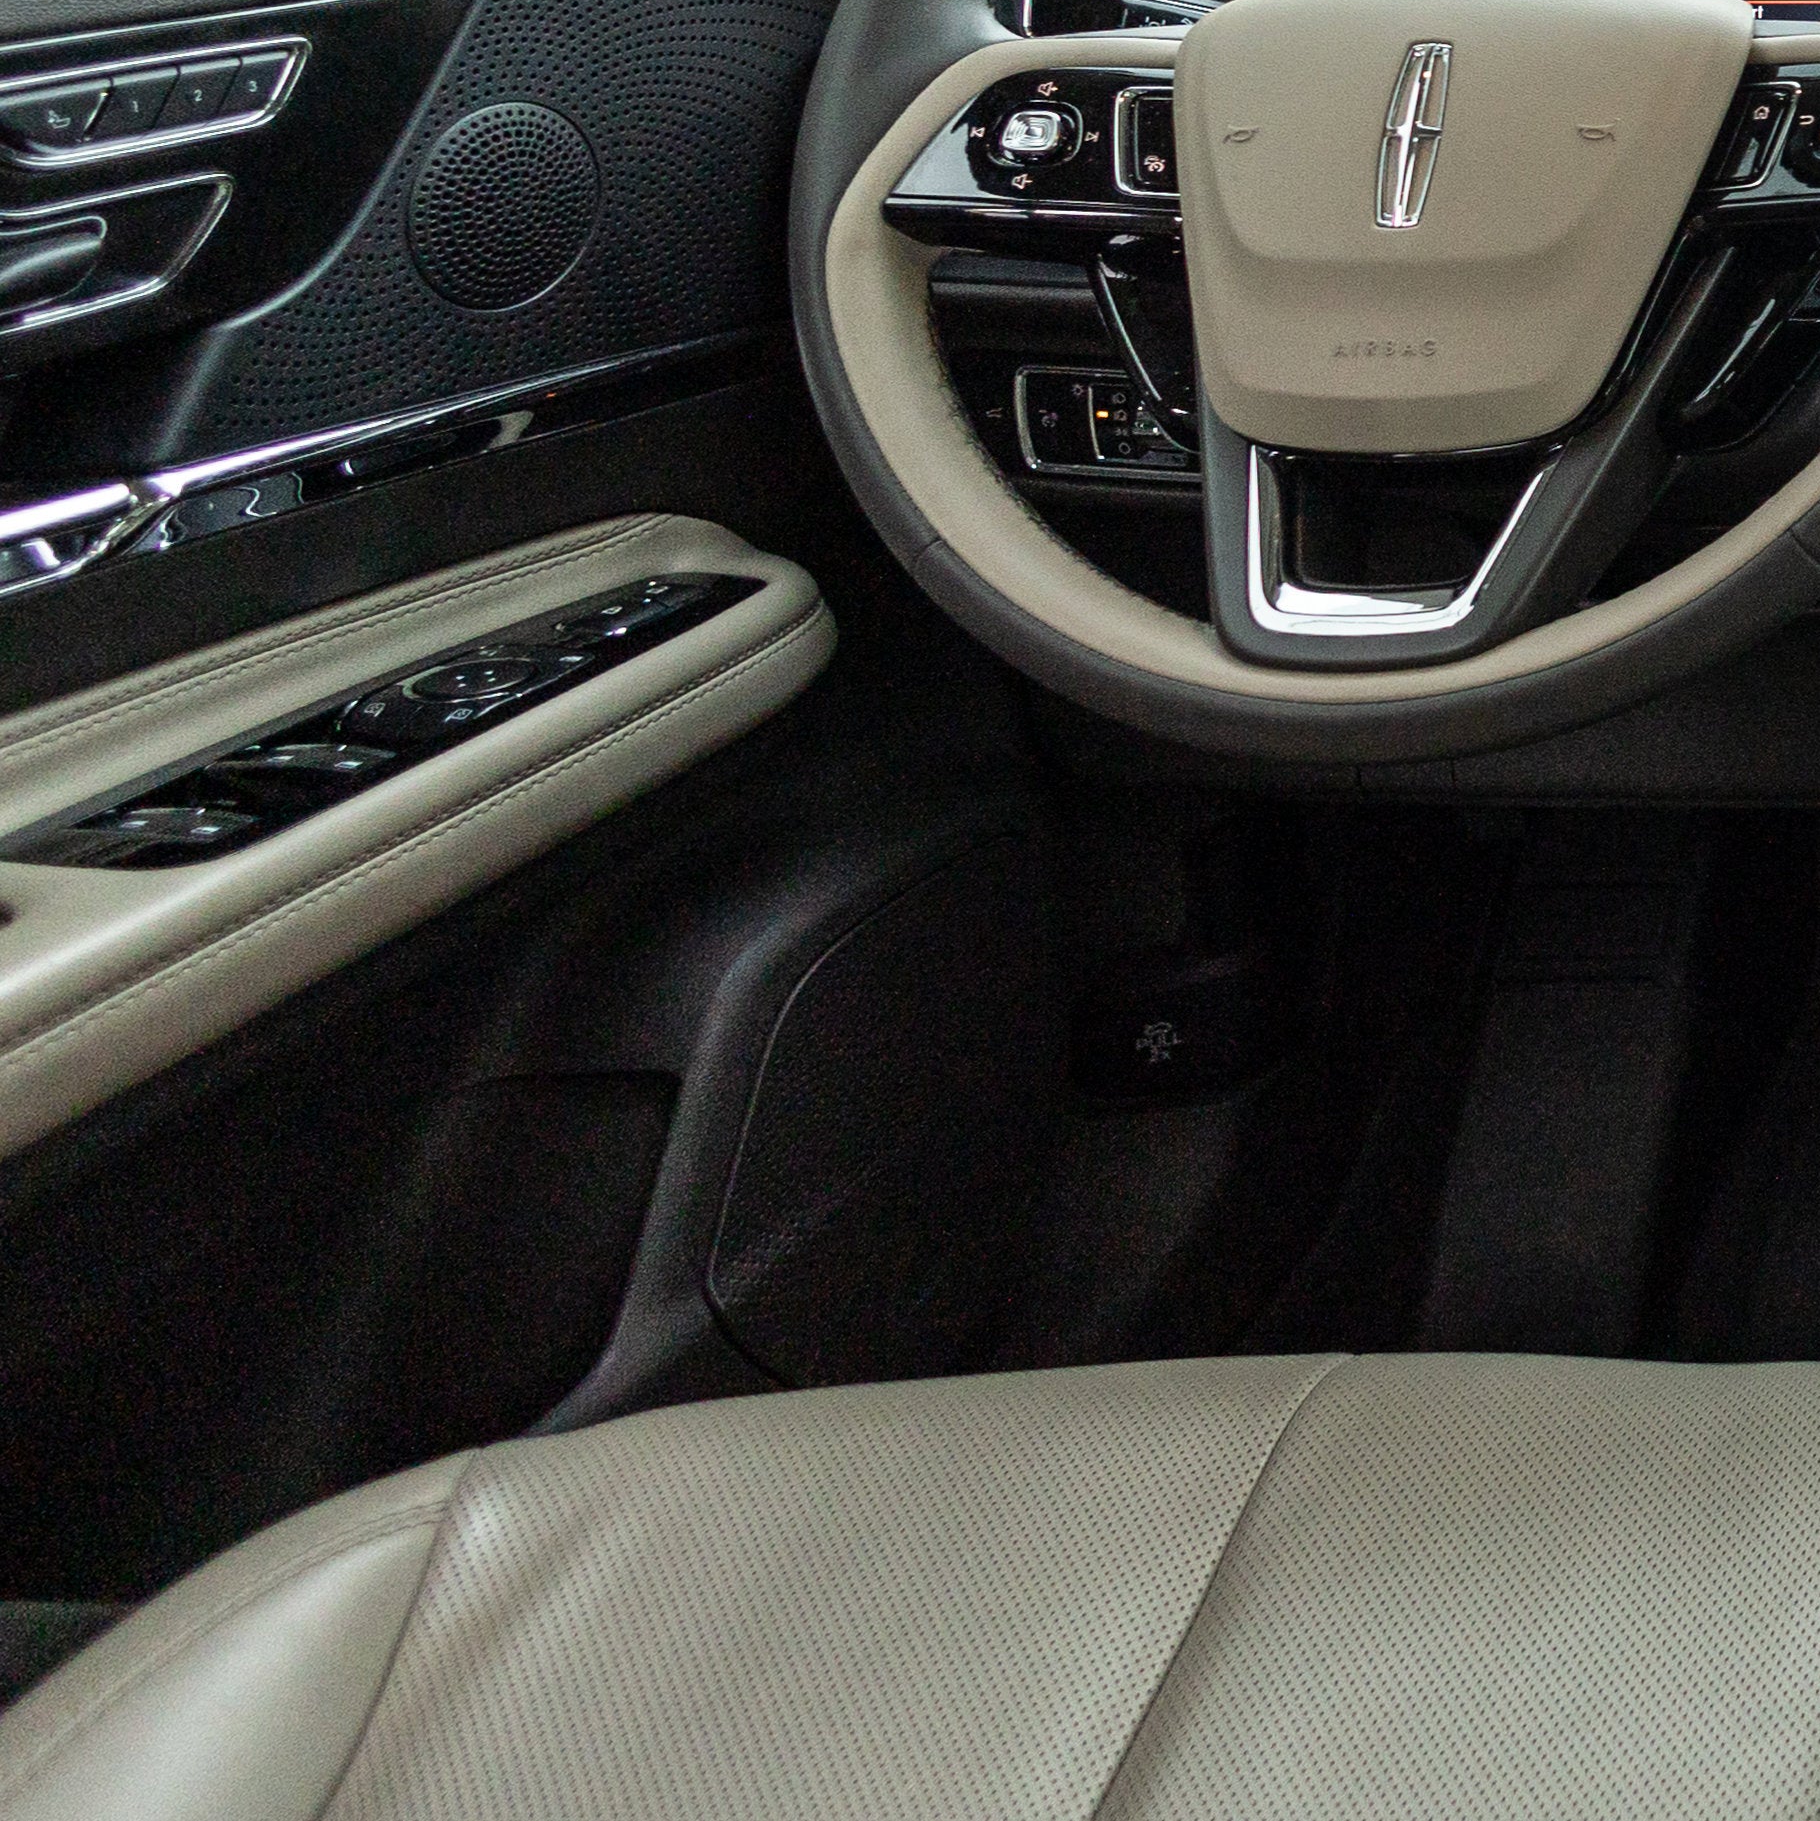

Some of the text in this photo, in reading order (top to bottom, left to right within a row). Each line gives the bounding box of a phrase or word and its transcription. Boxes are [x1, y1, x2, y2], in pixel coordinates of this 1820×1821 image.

[249, 80, 258, 92] 3
[193, 88, 203, 102] 2
[132, 100, 139, 113] 1
[1331, 340, 1437, 358] AIRBAG
